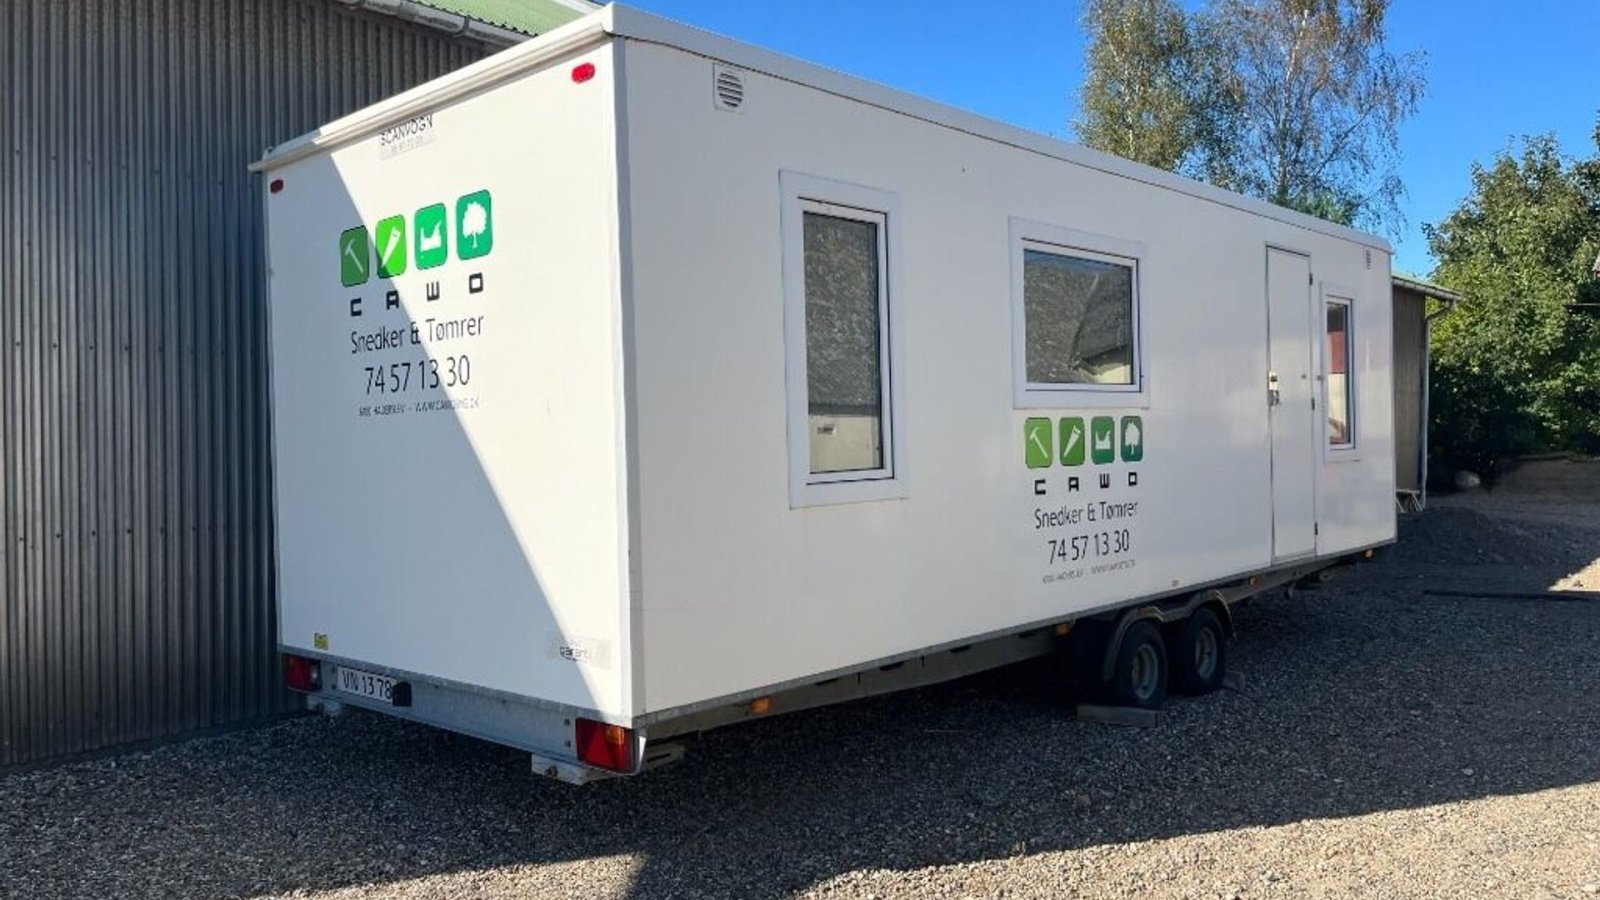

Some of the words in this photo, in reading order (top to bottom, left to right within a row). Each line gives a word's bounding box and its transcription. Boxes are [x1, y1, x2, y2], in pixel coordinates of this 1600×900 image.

[350, 272, 484, 317] CAWO
[351, 325, 405, 354] Snedker
[410, 321, 421, 345] &
[425, 315, 484, 342] Tømrer
[364, 365, 386, 395] 74
[390, 362, 411, 393] 57
[418, 359, 440, 390] 13
[446, 354, 470, 387] 30
[1034, 471, 1138, 495] CAWO
[1034, 505, 1084, 529] Snedker
[1087, 503, 1096, 521] &
[1099, 501, 1139, 520] Tømrer
[1048, 538, 1067, 565] 74
[1071, 535, 1089, 561] 57
[1094, 532, 1109, 556] 13
[1113, 529, 1130, 554] 30
[362, 676, 375, 695] 13
[376, 679, 393, 699] 78
